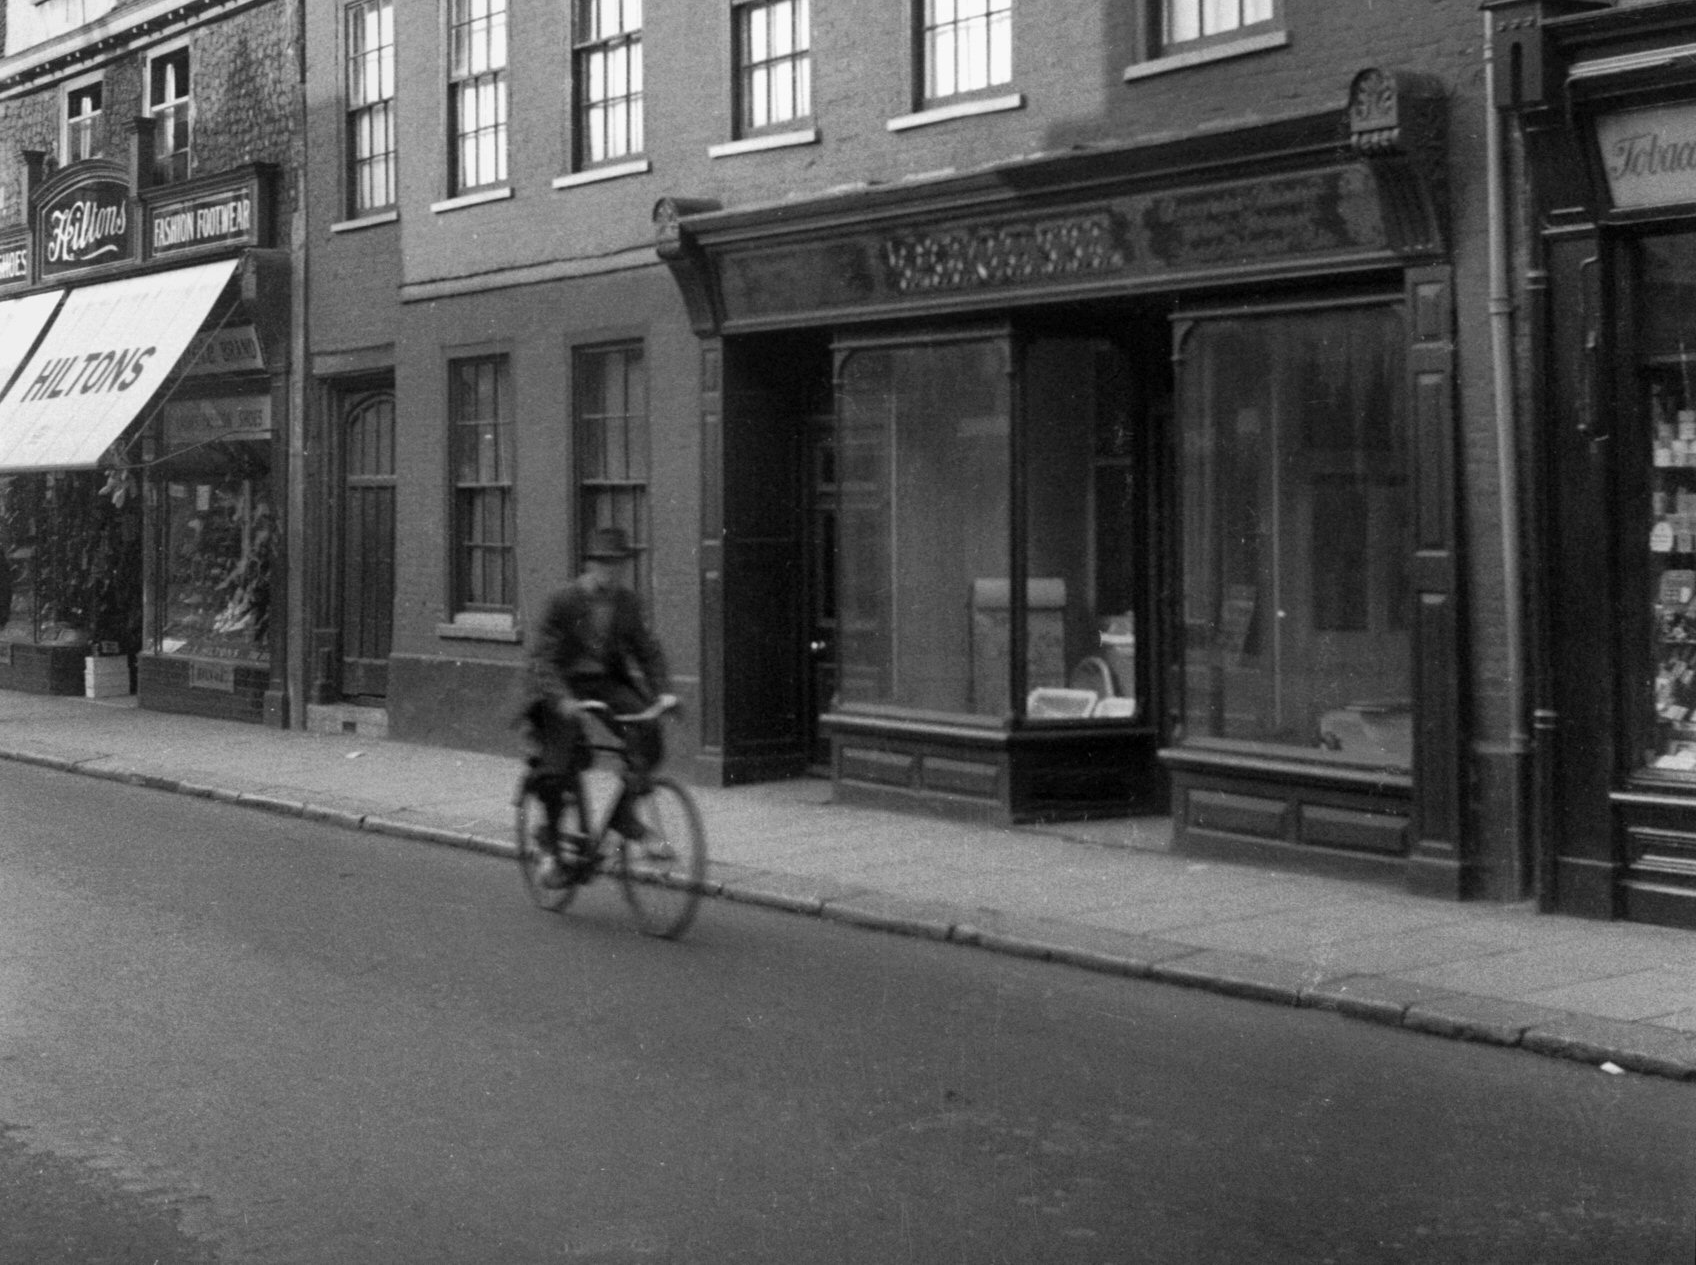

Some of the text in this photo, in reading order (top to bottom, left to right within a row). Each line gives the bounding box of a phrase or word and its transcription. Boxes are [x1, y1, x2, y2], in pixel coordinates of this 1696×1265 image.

[48, 200, 127, 262] Hiltons
[154, 199, 250, 248] FASHION FOOTWEAR
[20, 346, 156, 403] HILTONS
